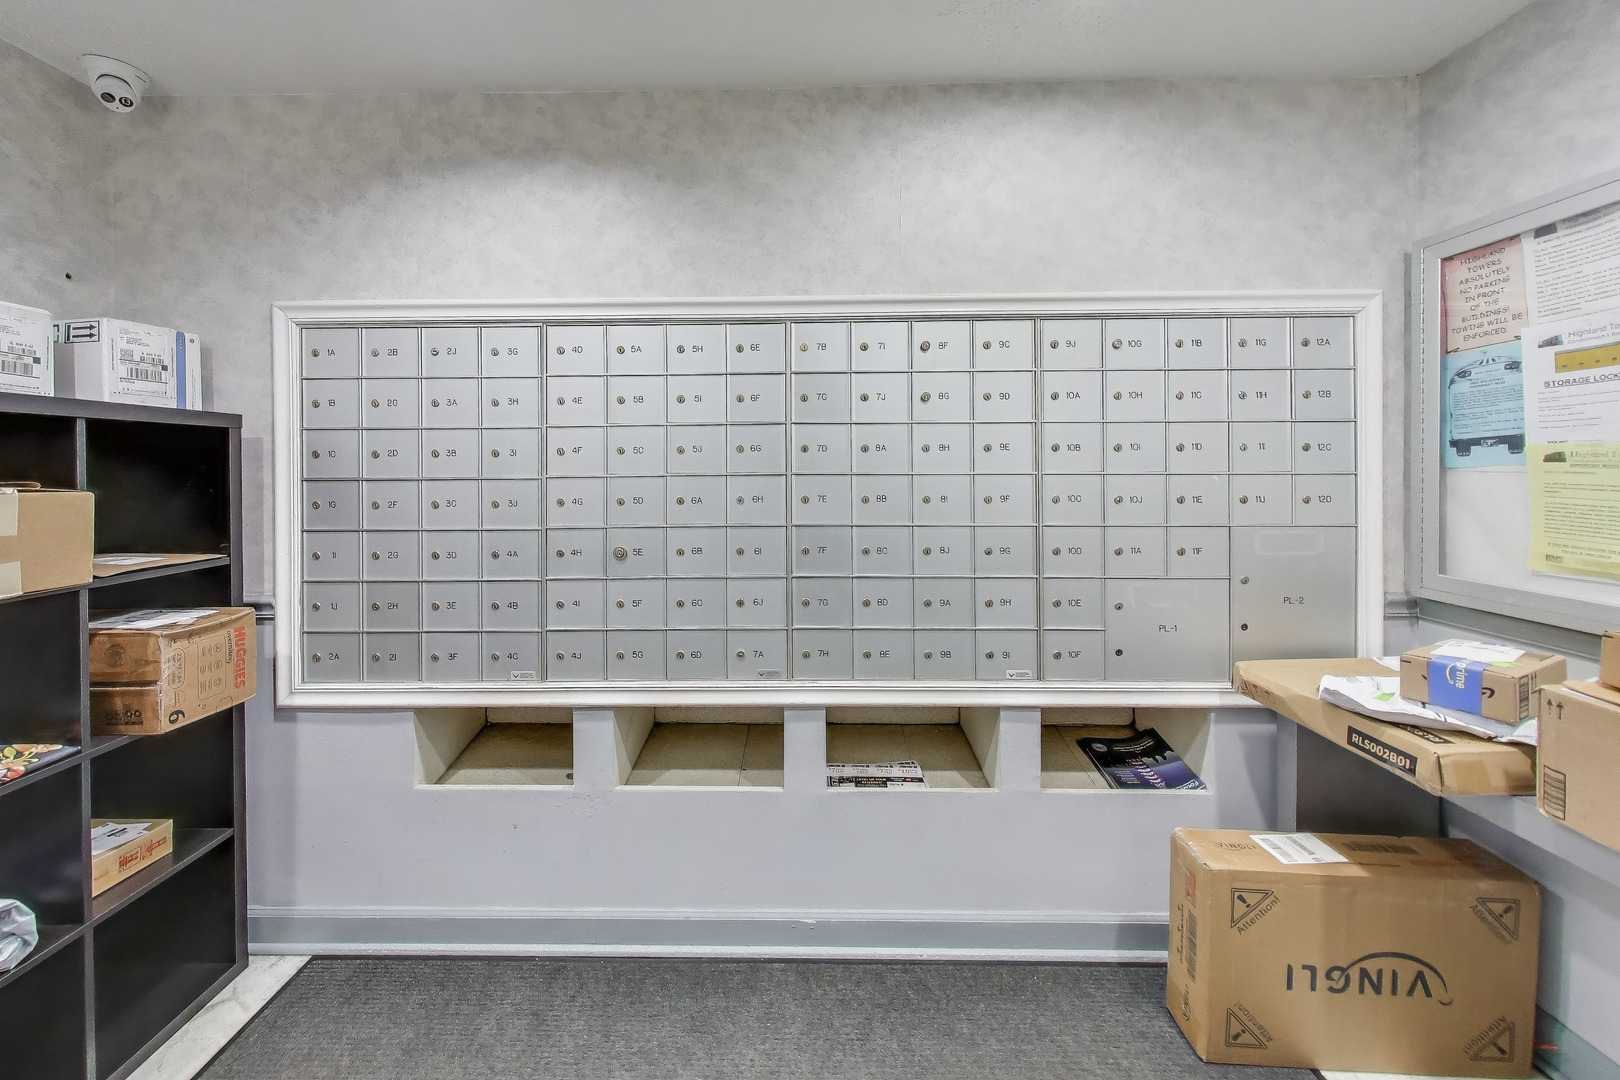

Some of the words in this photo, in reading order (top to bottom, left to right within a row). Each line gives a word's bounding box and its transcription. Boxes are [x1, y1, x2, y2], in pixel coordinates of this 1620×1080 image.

[1460, 247, 1506, 266] HIGHLAND
[1467, 258, 1502, 273] TOWERS
[1459, 265, 1511, 286] ABSOLUTELY
[1459, 286, 1472, 295] NO
[1474, 275, 1511, 291] PARKING
[1465, 295, 1476, 303] IN
[1477, 286, 1506, 300] FRONT
[1470, 303, 1481, 311] OF
[1484, 297, 1500, 307] THE
[1451, 321, 1485, 335] TOWING
[1486, 317, 1509, 327] WILL
[1511, 312, 1524, 321] BE
[816, 342, 827, 351] 7B
[937, 341, 949, 350] 8F
[1065, 339, 1077, 348] 9J
[1191, 339, 1203, 348] 11B
[1316, 338, 1331, 347] 12A
[446, 347, 457, 356] 2J
[571, 345, 584, 354] 4D
[630, 344, 643, 354] 5A
[691, 344, 704, 353] 5H
[749, 343, 761, 352] 6E
[327, 348, 336, 357] 1A
[387, 348, 399, 357] 2B
[1544, 375, 1591, 388] STORAGE
[1593, 372, 1620, 383] LOCK
[750, 394, 761, 403] 6F
[876, 392, 886, 401] 7J
[998, 392, 1011, 401] 9D
[1066, 391, 1081, 400] 10A
[1128, 391, 1143, 400] 10H
[1255, 391, 1268, 400] 11H
[1317, 389, 1332, 399] 12B
[327, 398, 336, 407] 1B
[446, 398, 458, 407] 3A
[507, 397, 519, 406] 3H
[571, 396, 583, 405] 4E
[633, 395, 644, 404] 5B
[571, 446, 583, 455] 4F
[692, 445, 703, 454] 5J
[816, 444, 828, 453] 7D
[875, 443, 887, 452] 8A
[938, 443, 950, 452] 8H
[999, 442, 1010, 451] 9E
[1067, 443, 1081, 452] 10B
[1191, 442, 1203, 451] 11D
[387, 449, 399, 458] 2D
[445, 449, 457, 458] 3B
[632, 496, 644, 505] 5D
[690, 496, 703, 505] 6A
[751, 495, 764, 504] 6H
[817, 494, 828, 503] 7E
[876, 494, 887, 503] 8B
[999, 494, 1011, 503] 9F
[1129, 495, 1143, 504] 10J
[1192, 495, 1203, 504] 11E
[1255, 495, 1266, 504] 11J
[387, 500, 398, 509] 2F
[507, 499, 518, 508] 3J
[506, 550, 519, 559] 4A
[570, 548, 582, 557] 4H
[632, 548, 644, 557] 5E
[691, 546, 703, 555] 6B
[939, 546, 950, 555] 8J
[1130, 547, 1142, 556] 11A
[1191, 547, 1203, 556] 11F
[445, 551, 457, 560] 3D
[632, 599, 643, 608] 5F
[752, 598, 764, 607] 6J
[876, 598, 889, 607] 8D
[939, 598, 952, 607] 9A
[999, 598, 1012, 607] 9H
[1067, 598, 1082, 607] 10E
[1283, 596, 1305, 605] PL-2
[330, 602, 338, 611] 1J
[387, 601, 399, 610] 2H
[445, 601, 457, 610] 3E
[506, 601, 519, 610] 4B
[1158, 624, 1178, 633] PL-1
[233, 626, 247, 690] HUGGIES
[328, 652, 340, 661] 2A
[447, 652, 458, 661] 3F
[571, 652, 582, 661] 4J
[690, 650, 702, 659] 6D
[752, 650, 764, 659] 7A
[817, 649, 829, 658] 7H
[879, 650, 891, 659] 8E
[939, 650, 952, 659] 9B
[1068, 650, 1082, 659] 10F
[1455, 661, 1468, 689] prime
[168, 709, 186, 724] 6
[1351, 733, 1411, 770] RLS002B01
[1236, 895, 1281, 935] Attention!
[1286, 958, 1436, 999] VINGLI
